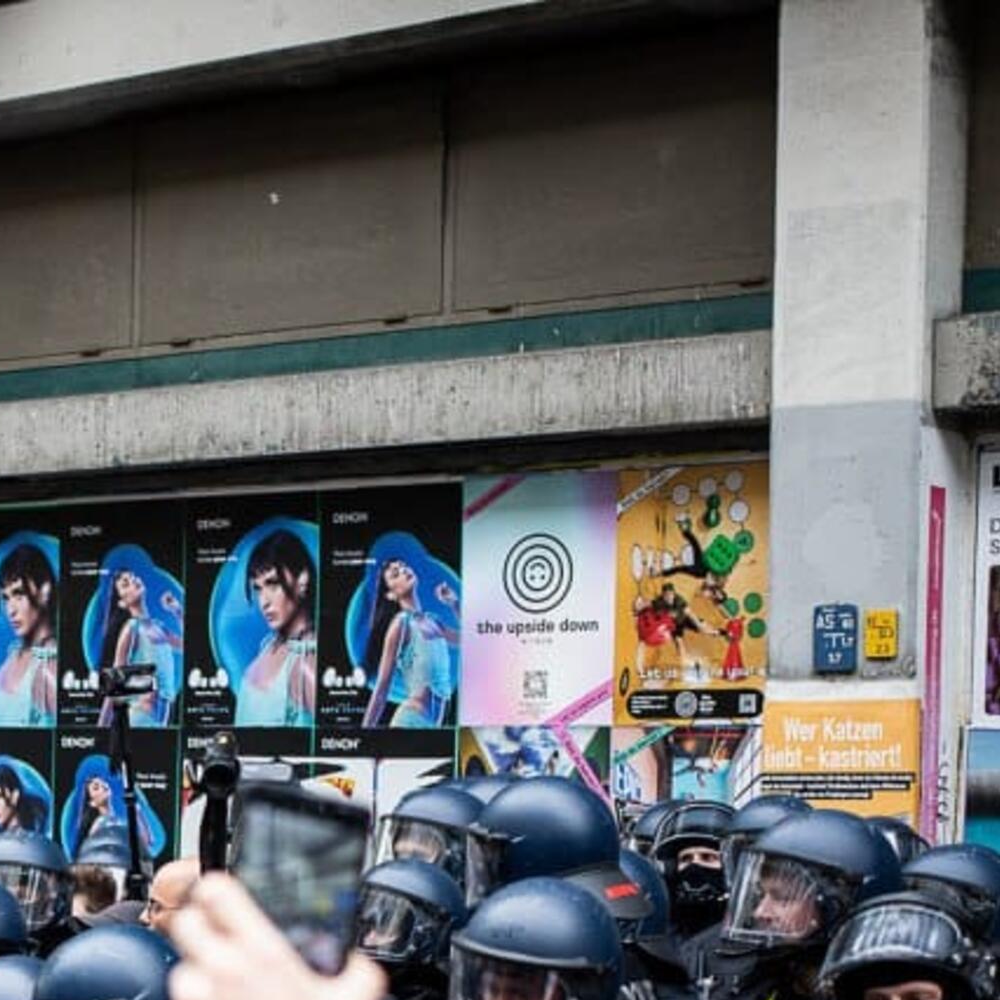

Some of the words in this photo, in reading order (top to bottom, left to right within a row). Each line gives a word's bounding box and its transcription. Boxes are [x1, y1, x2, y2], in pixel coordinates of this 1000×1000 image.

[477, 621, 503, 634] the
[506, 619, 555, 637] upside
[559, 618, 600, 632] down
[784, 716, 816, 742] Wer
[822, 716, 884, 742] Katzen
[320, 736, 358, 750] DENON
[818, 742, 903, 768] kastriert!
